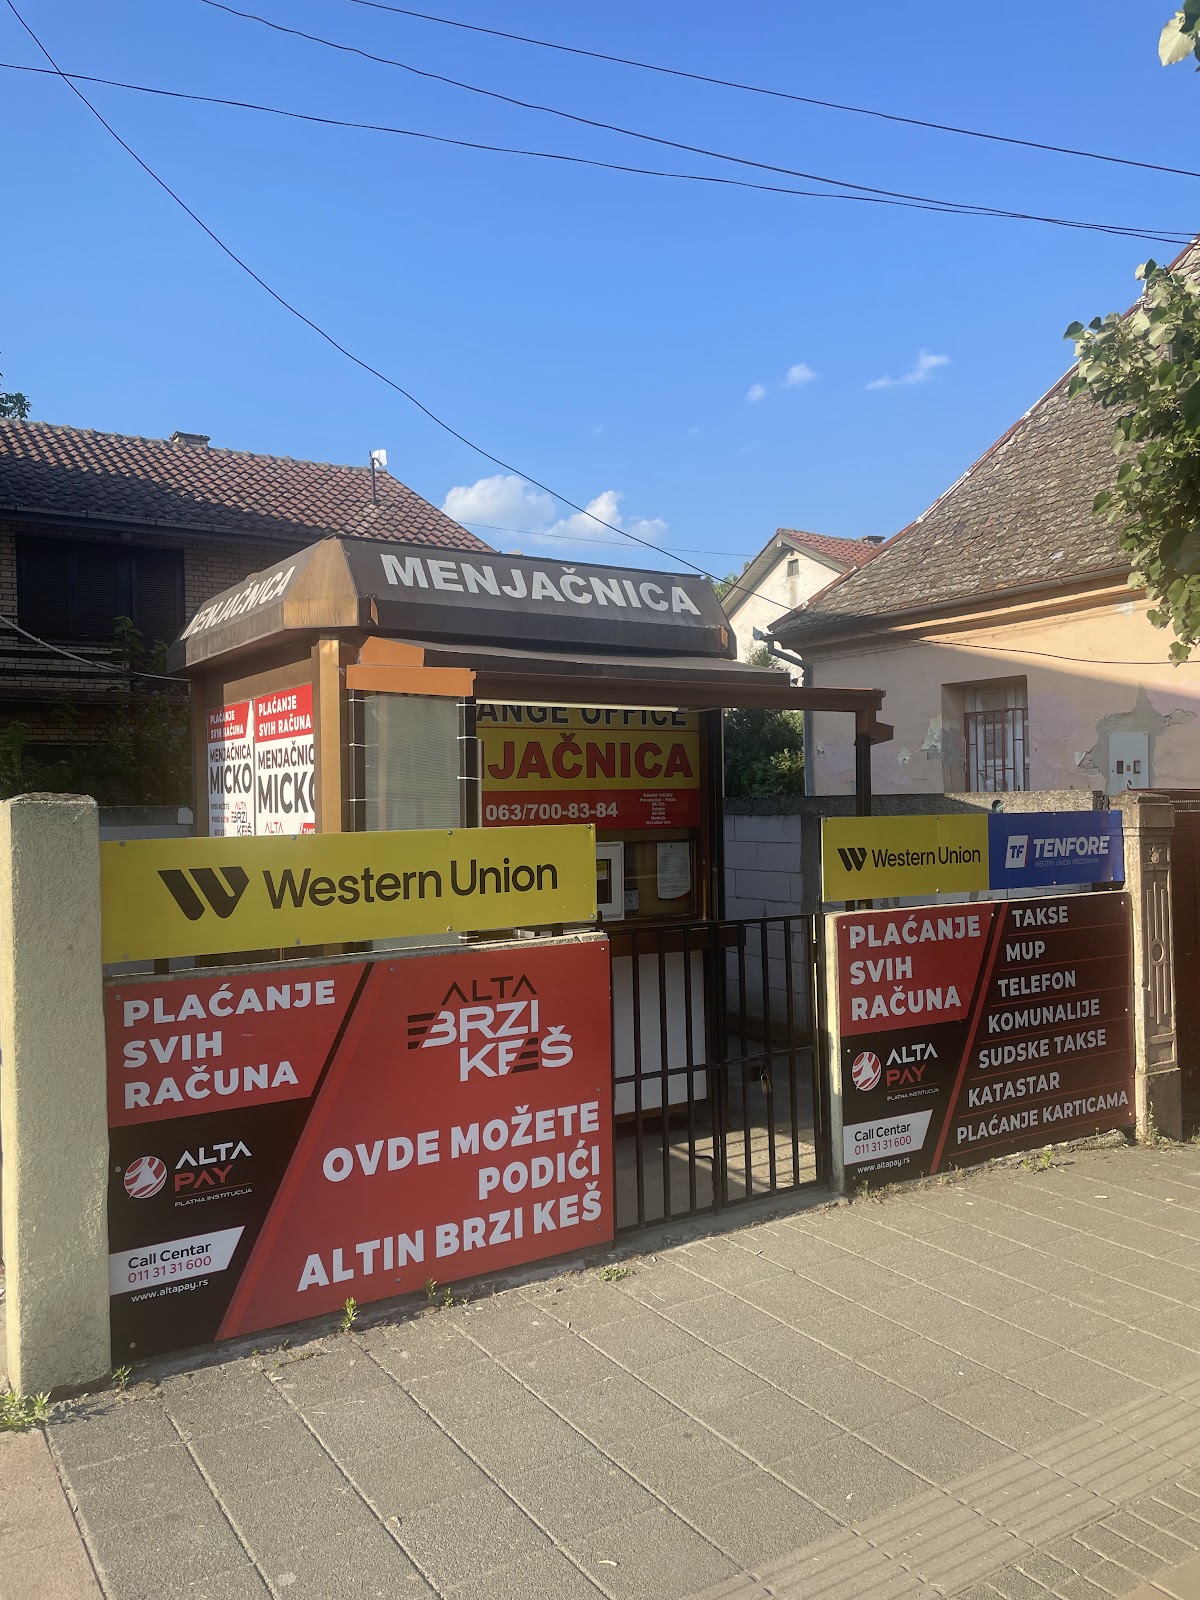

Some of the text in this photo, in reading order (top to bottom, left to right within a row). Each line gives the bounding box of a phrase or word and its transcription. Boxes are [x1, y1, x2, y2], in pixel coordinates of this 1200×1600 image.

[380, 554, 701, 616] MENJAČNICA
[210, 709, 235, 725] PLAĆANJE
[258, 695, 297, 717] PLAĆANJE
[210, 723, 244, 740] SVIH RAČUNA
[259, 713, 312, 737] SVIH RAČUNA
[209, 742, 252, 763] MENJAČNICA
[482, 733, 694, 779] JAČNICA
[210, 763, 252, 795] MICKO
[485, 802, 618, 821] 063/700-83-84
[265, 822, 284, 834] ALTA
[871, 848, 936, 868] Western
[938, 845, 981, 865] Union
[1010, 845, 1025, 859] TF
[1033, 836, 1110, 858] TENFORE
[262, 866, 442, 909] Western
[450, 857, 558, 896] Union
[1012, 905, 1068, 928] TAKSE
[850, 914, 980, 949] PLAĆANJE
[1006, 941, 1046, 962] MUP
[850, 956, 912, 985] SVIH
[998, 970, 1076, 998] TELEFON
[123, 979, 335, 1027] PLAĆANJE
[441, 974, 537, 1006] ALTA
[851, 985, 961, 1021] RAČUNA
[407, 999, 539, 1049] BRZI
[988, 999, 1100, 1033] KOMUNALIJE
[123, 1030, 222, 1068] SVIH
[459, 1024, 574, 1082] KEŠ
[886, 1042, 938, 1066] ALTA
[978, 1028, 1107, 1069] SUDSKE TAKSE
[124, 1060, 299, 1110] RAČUNA
[886, 1064, 927, 1087] PAY
[968, 1071, 1060, 1108] KATASTAR
[887, 1087, 939, 1101] PLATNA INSTITUCIJA
[957, 1090, 1129, 1145] PLAĆANJE KARTICAMA
[322, 1101, 600, 1182] OVDE MOŽETE
[854, 1123, 911, 1142] Call Centar
[854, 1135, 912, 1155] 011 31 31 600
[174, 1140, 252, 1170] ALTA
[857, 1156, 910, 1174] www.altapay.rs
[174, 1164, 234, 1192] PAY
[478, 1139, 600, 1200] PODIĆI
[174, 1188, 252, 1208] PLATNA INSTITUCIJA
[297, 1180, 602, 1292] ALTIN BRZI KEŠ
[128, 1243, 211, 1269] Call Centar
[128, 1255, 211, 1283] 011 31 31 600
[131, 1278, 209, 1303] www.altapay.rs
